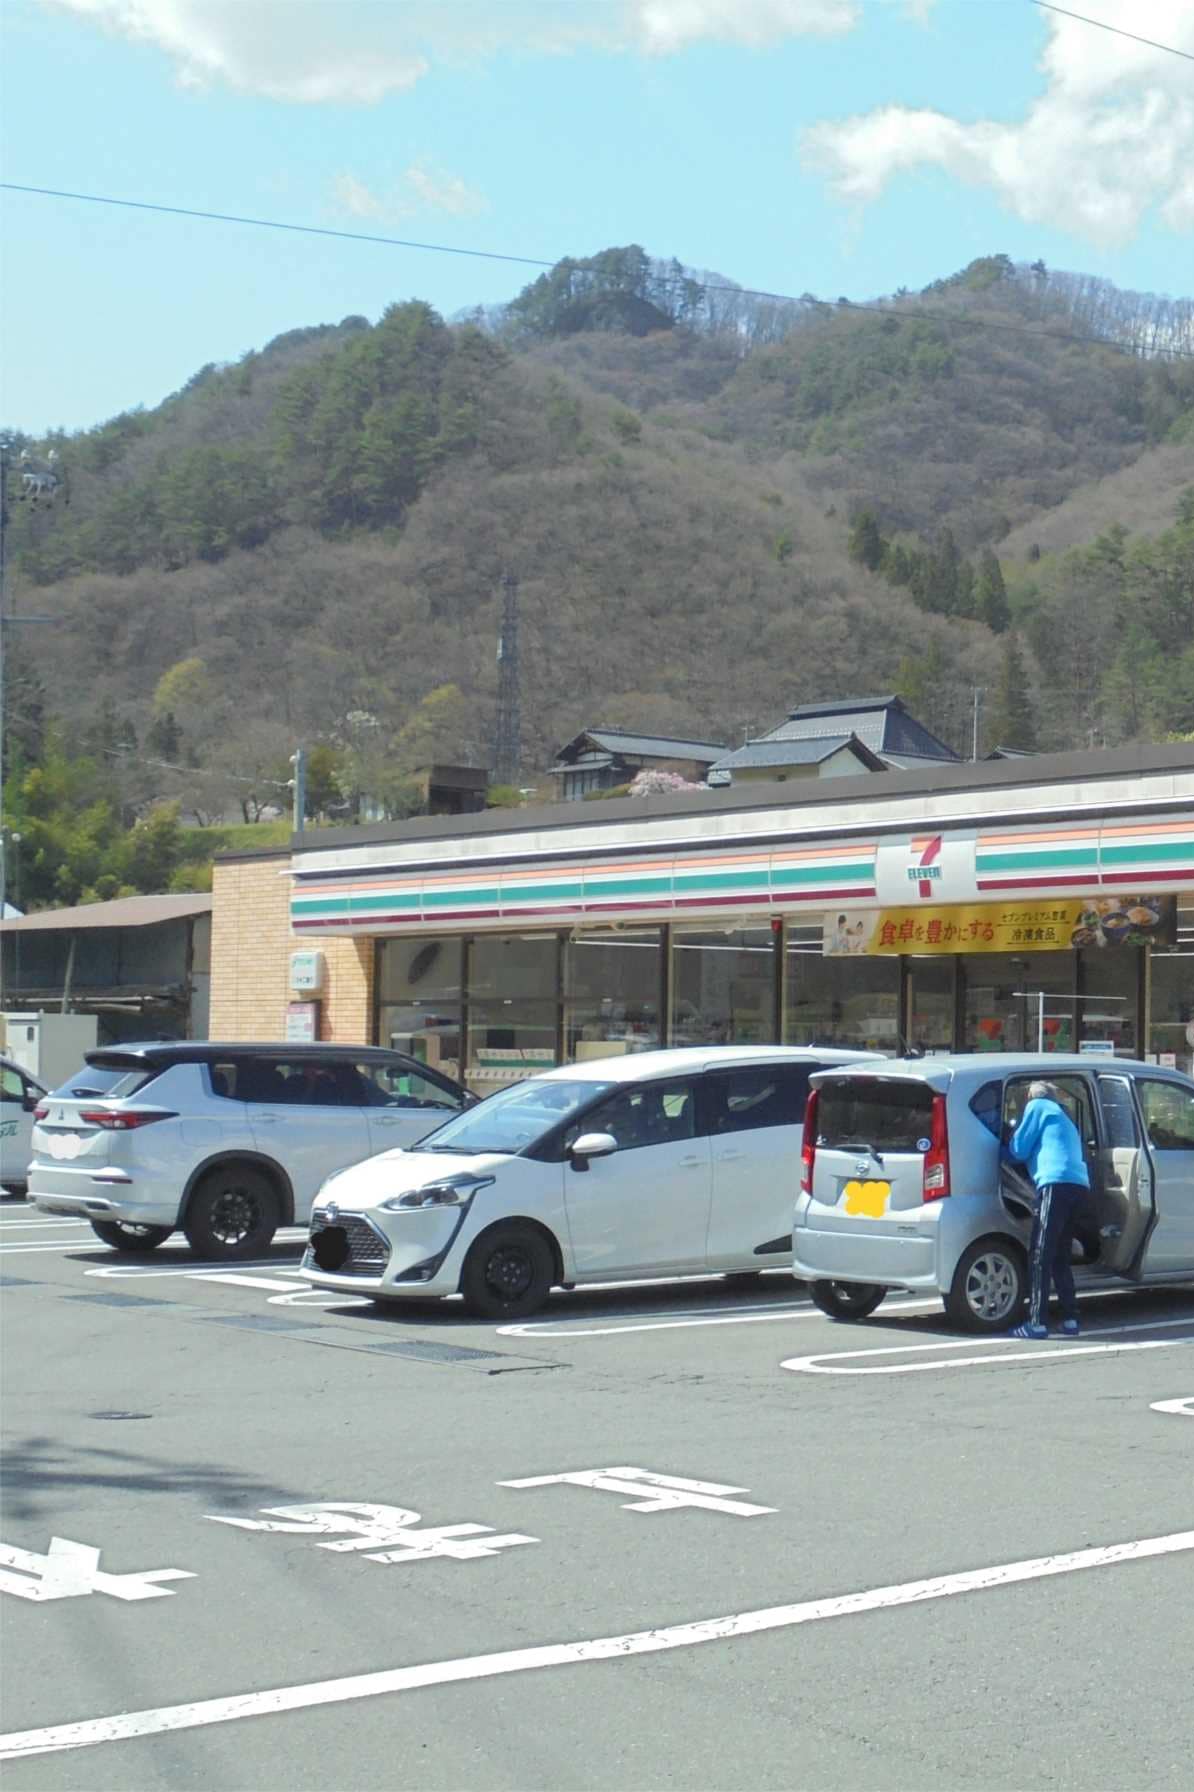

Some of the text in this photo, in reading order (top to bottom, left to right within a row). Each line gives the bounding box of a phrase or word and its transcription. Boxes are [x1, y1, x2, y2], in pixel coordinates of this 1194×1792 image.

[879, 918, 994, 947] 食卓を豊かにする
[1012, 927, 1056, 941] 冷凍食品
